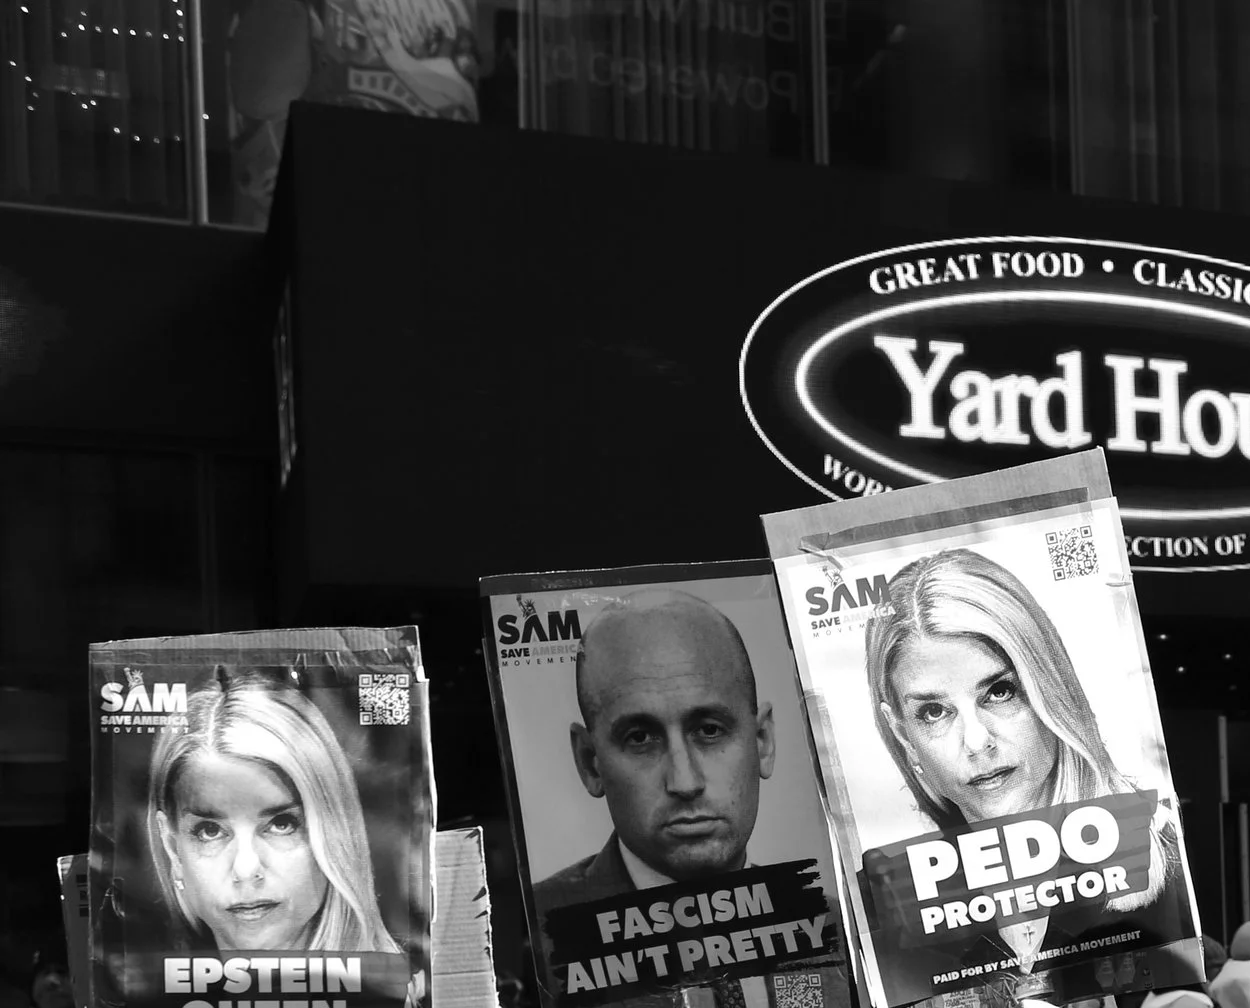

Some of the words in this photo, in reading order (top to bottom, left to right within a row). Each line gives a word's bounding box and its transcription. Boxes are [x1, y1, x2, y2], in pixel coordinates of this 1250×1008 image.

[869, 253, 981, 295] GREAT
[992, 251, 1084, 278] FOOD
[873, 335, 1093, 449] Yard
[824, 453, 893, 497] WOR
[1215, 533, 1247, 556] OF
[805, 574, 892, 616] SAM
[498, 609, 582, 645] SAM
[810, 616, 841, 630] SAVE
[500, 647, 531, 659] SAVE
[502, 656, 577, 667] MOVEMEN
[100, 681, 188, 713] SAM
[100, 715, 132, 726] SAVE
[133, 715, 189, 726] AMERICA
[906, 805, 1120, 901] PEDO
[596, 882, 774, 944] FASCISM
[920, 866, 1131, 935] PROTECTOR
[164, 957, 362, 994] EPSTEIN
[567, 944, 670, 994] AIN'T
[677, 915, 827, 973] PRETTY
[933, 971, 960, 985] PAID
[960, 965, 983, 979] FOR
[984, 961, 999, 973] BY
[1080, 929, 1142, 951] MOVEMENT
